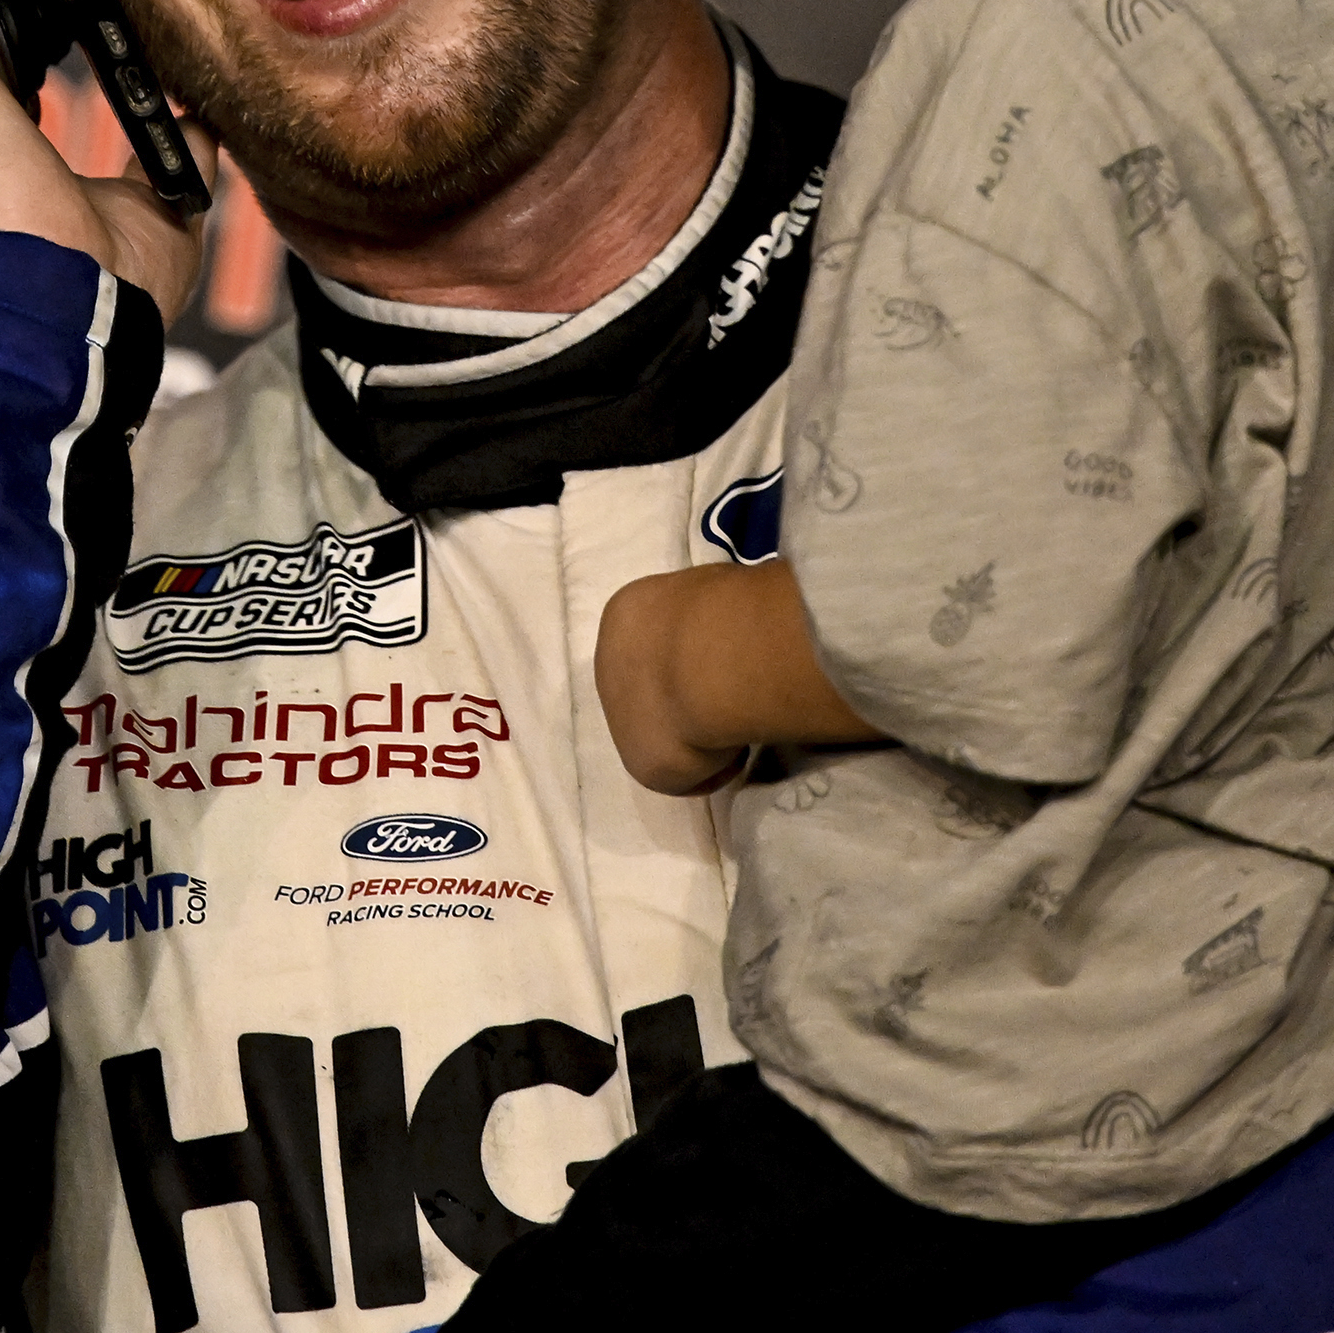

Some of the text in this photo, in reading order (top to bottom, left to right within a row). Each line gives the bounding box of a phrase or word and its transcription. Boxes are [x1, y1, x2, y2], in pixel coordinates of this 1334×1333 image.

[212, 536, 376, 592] NASCAR
[143, 581, 377, 641] CUP SERIES
[73, 742, 481, 793] TRACTORS
[28, 818, 154, 902] HIGH
[367, 821, 457, 853] Ford
[274, 878, 554, 906] FORD PERFORMANCE
[327, 904, 495, 926] RACING SCHOOL
